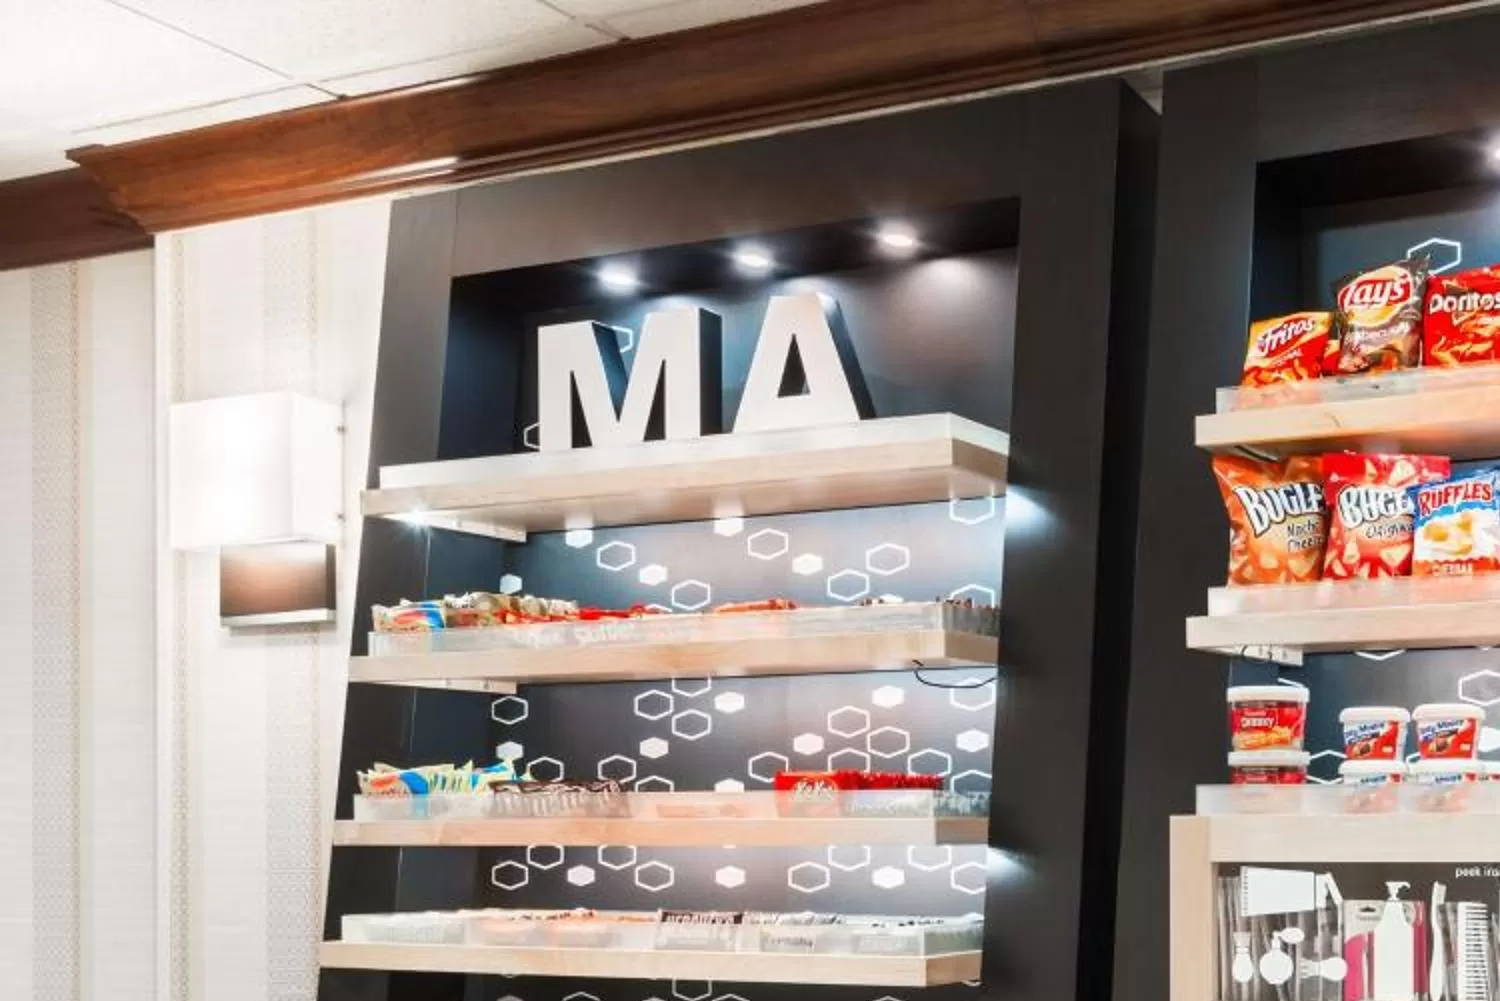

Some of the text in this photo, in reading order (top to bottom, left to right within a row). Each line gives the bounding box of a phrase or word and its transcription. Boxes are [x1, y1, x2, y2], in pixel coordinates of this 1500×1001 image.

[1256, 318, 1316, 357] Fritos
[1235, 483, 1323, 536] BUGLE
[1418, 482, 1493, 517] RUFFLES
[1455, 866, 1481, 879] peek
